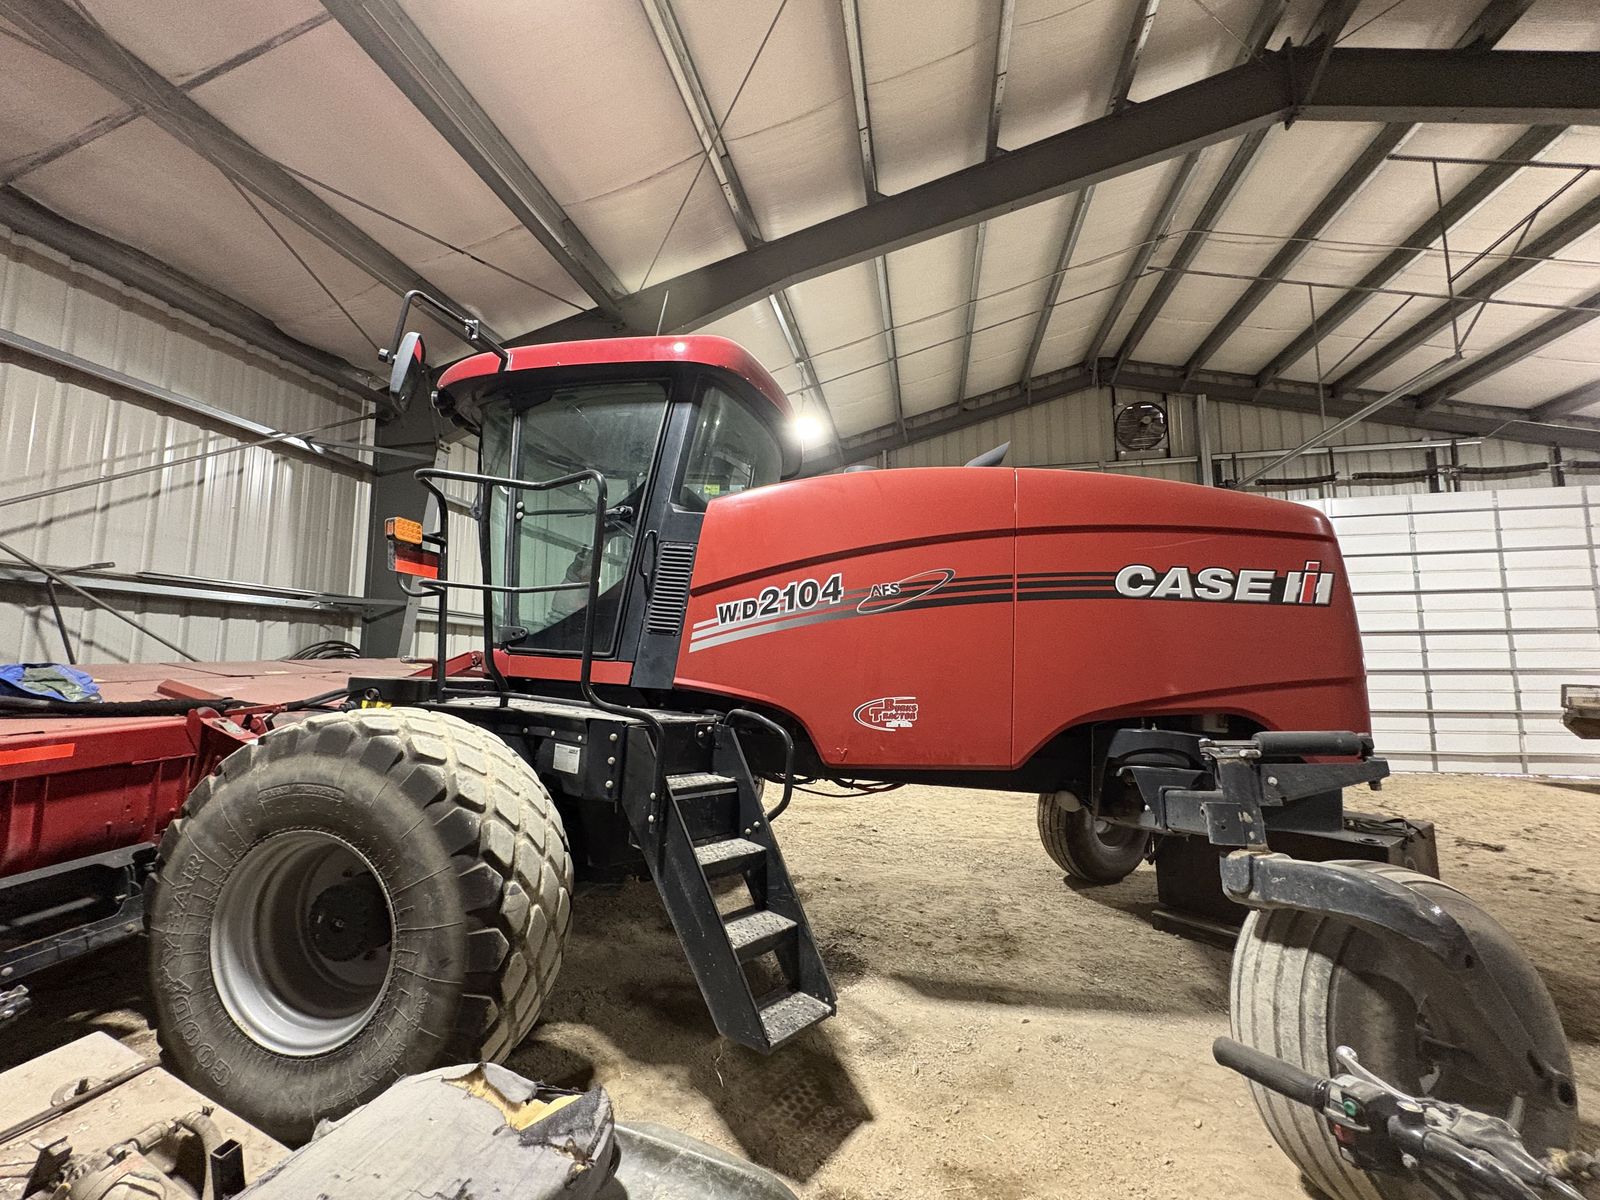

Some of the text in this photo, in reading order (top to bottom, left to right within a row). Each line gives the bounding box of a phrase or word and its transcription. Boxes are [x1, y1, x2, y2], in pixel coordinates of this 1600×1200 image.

[716, 572, 844, 626] WD2104
[869, 582, 900, 599] AFS
[1114, 563, 1277, 601] CASE
